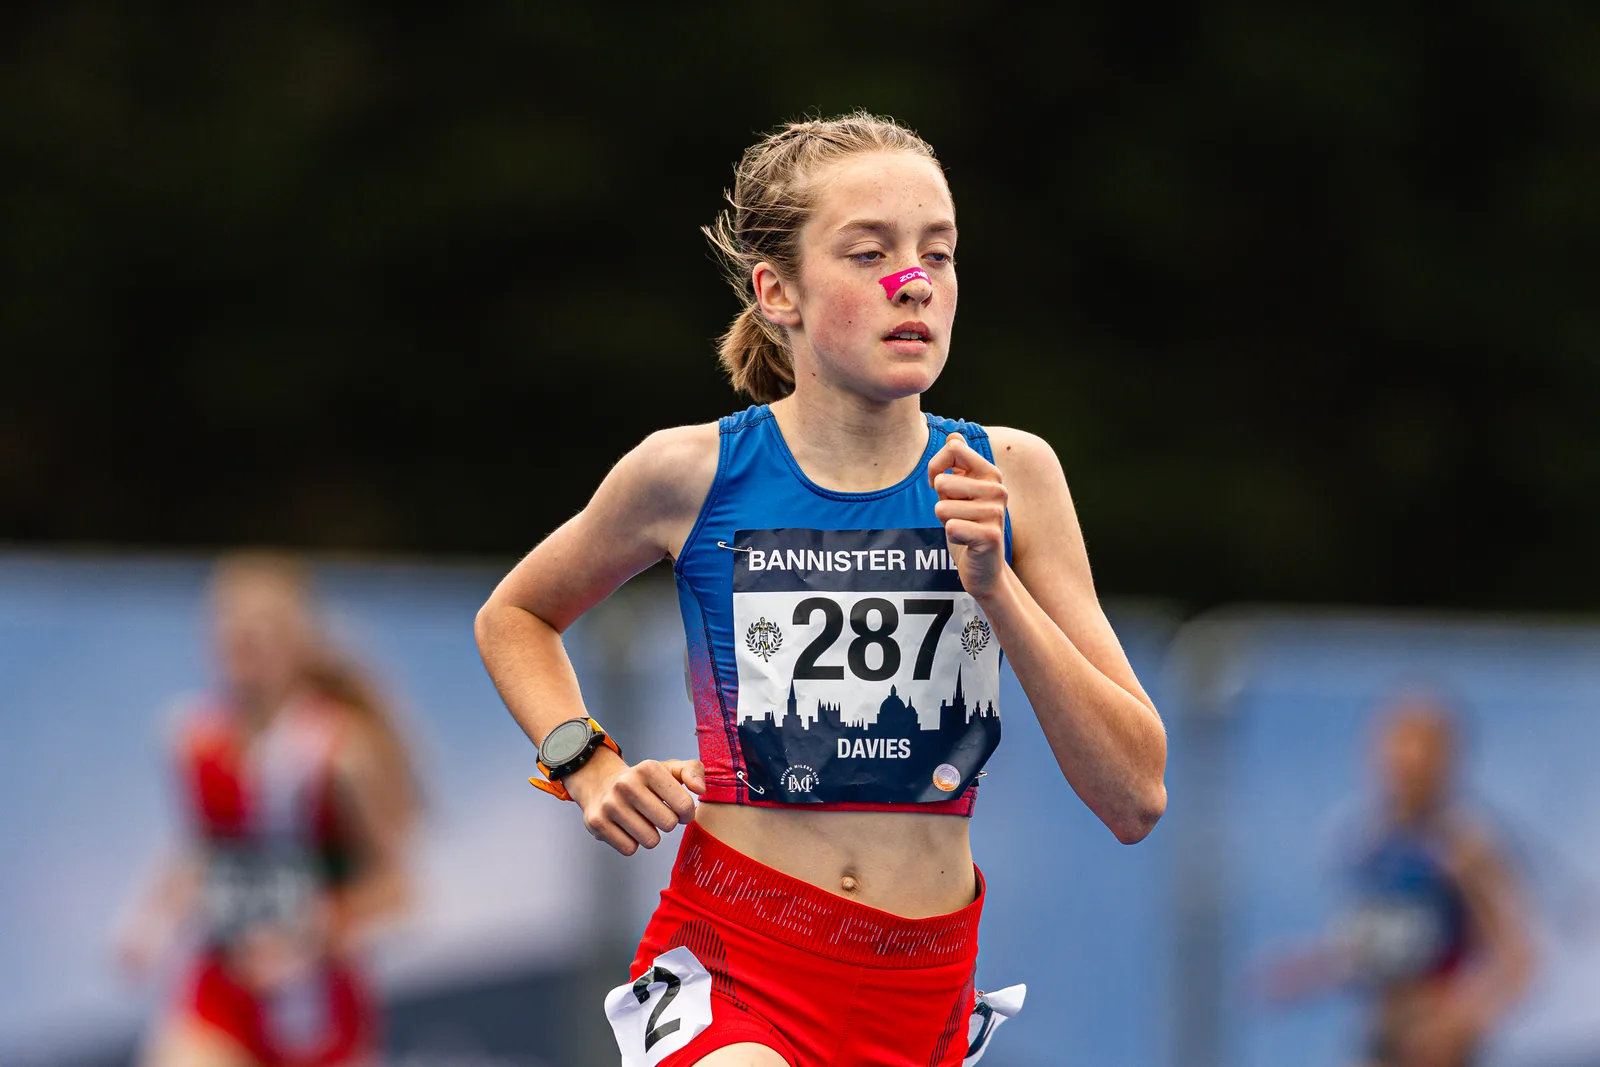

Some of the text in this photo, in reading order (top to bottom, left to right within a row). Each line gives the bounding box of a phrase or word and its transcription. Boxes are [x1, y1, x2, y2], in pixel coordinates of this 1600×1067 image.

[748, 548, 959, 572] BANNISTER MIL
[792, 597, 954, 681] 287
[837, 738, 911, 759] DAVIES
[632, 966, 681, 1054] 2
